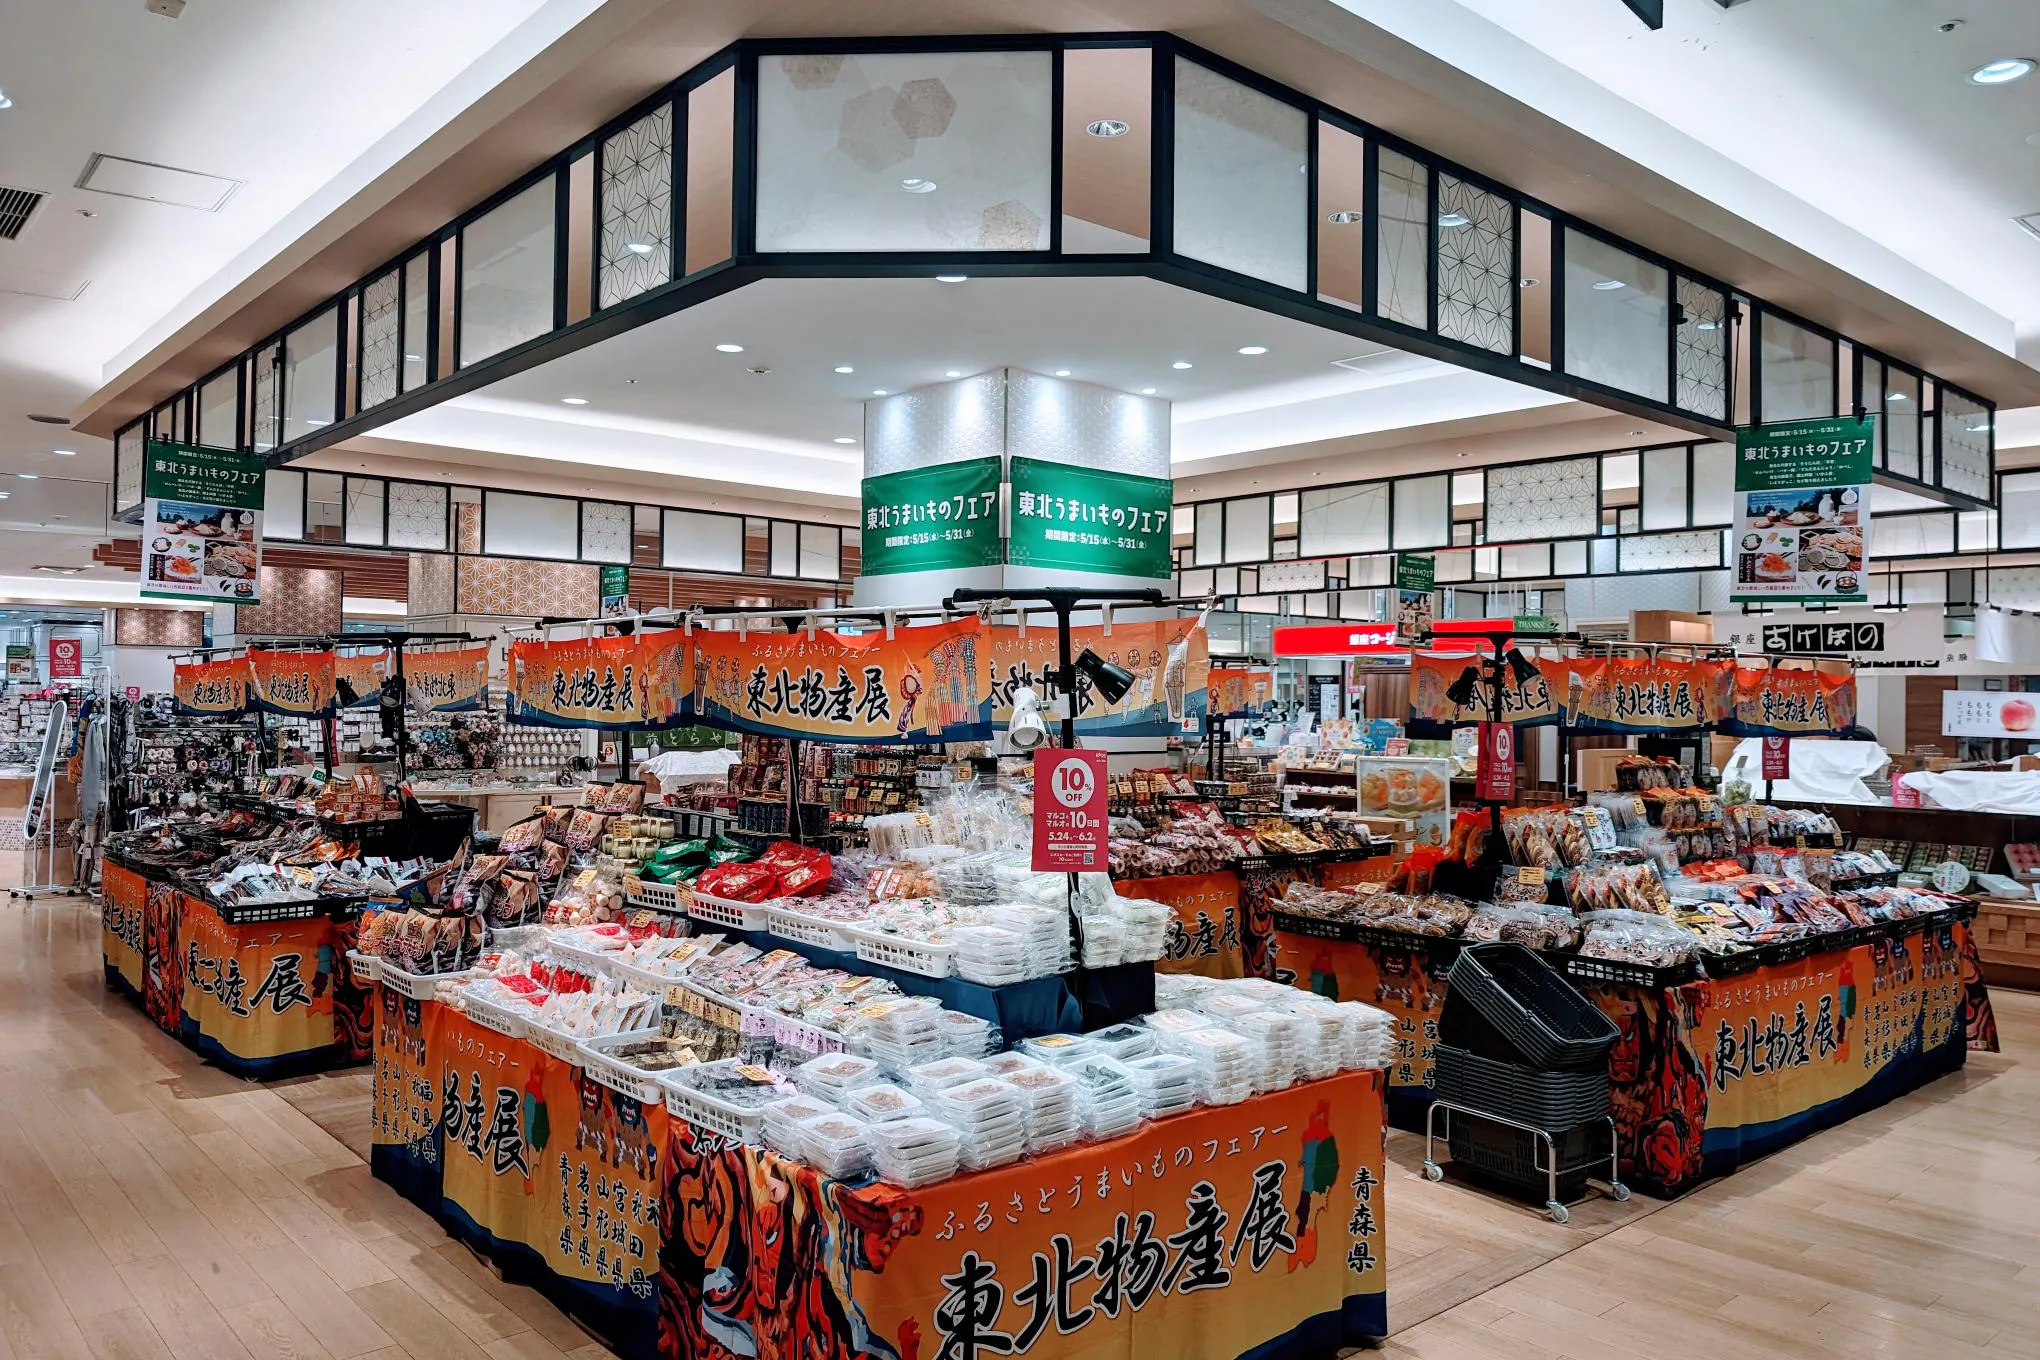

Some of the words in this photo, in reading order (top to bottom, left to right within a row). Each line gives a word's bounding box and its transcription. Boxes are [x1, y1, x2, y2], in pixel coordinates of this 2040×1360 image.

[155, 460, 260, 485] 東北うまいものフェア
[1744, 439, 1867, 461] 東北うまいものフェア
[867, 491, 996, 530] 東北うまいものフェア
[1018, 491, 1169, 534] 東北うまいものフェア
[1730, 633, 1756, 645] 銀座
[1764, 623, 1880, 650] あけぼの
[193, 676, 232, 706] 東北物産展
[269, 671, 310, 704] 東北物産展
[551, 664, 634, 712] 東北物産展
[746, 663, 890, 723] 東北物産展
[1615, 679, 1694, 720] 東北物産展
[1065, 793, 1083, 802] OFF
[1713, 972, 1833, 1011] ふるさとうまいものフェアー
[1398, 1016, 1417, 1084] 山形県
[1421, 1019, 1440, 1090] 宮城県
[1714, 993, 1838, 1094] 東北物産展
[421, 1079, 437, 1165] 福島県
[559, 1152, 574, 1256] 青森県
[935, 1124, 1290, 1242] ふるさとうまいものフェアー
[576, 1163, 592, 1268] 岩手県
[596, 1175, 610, 1279] 山形県
[611, 1179, 628, 1292] 宮城県
[628, 1190, 653, 1300] 秋田県
[1346, 1166, 1378, 1274] 青森県
[931, 1159, 1298, 1360] 東北物産展
